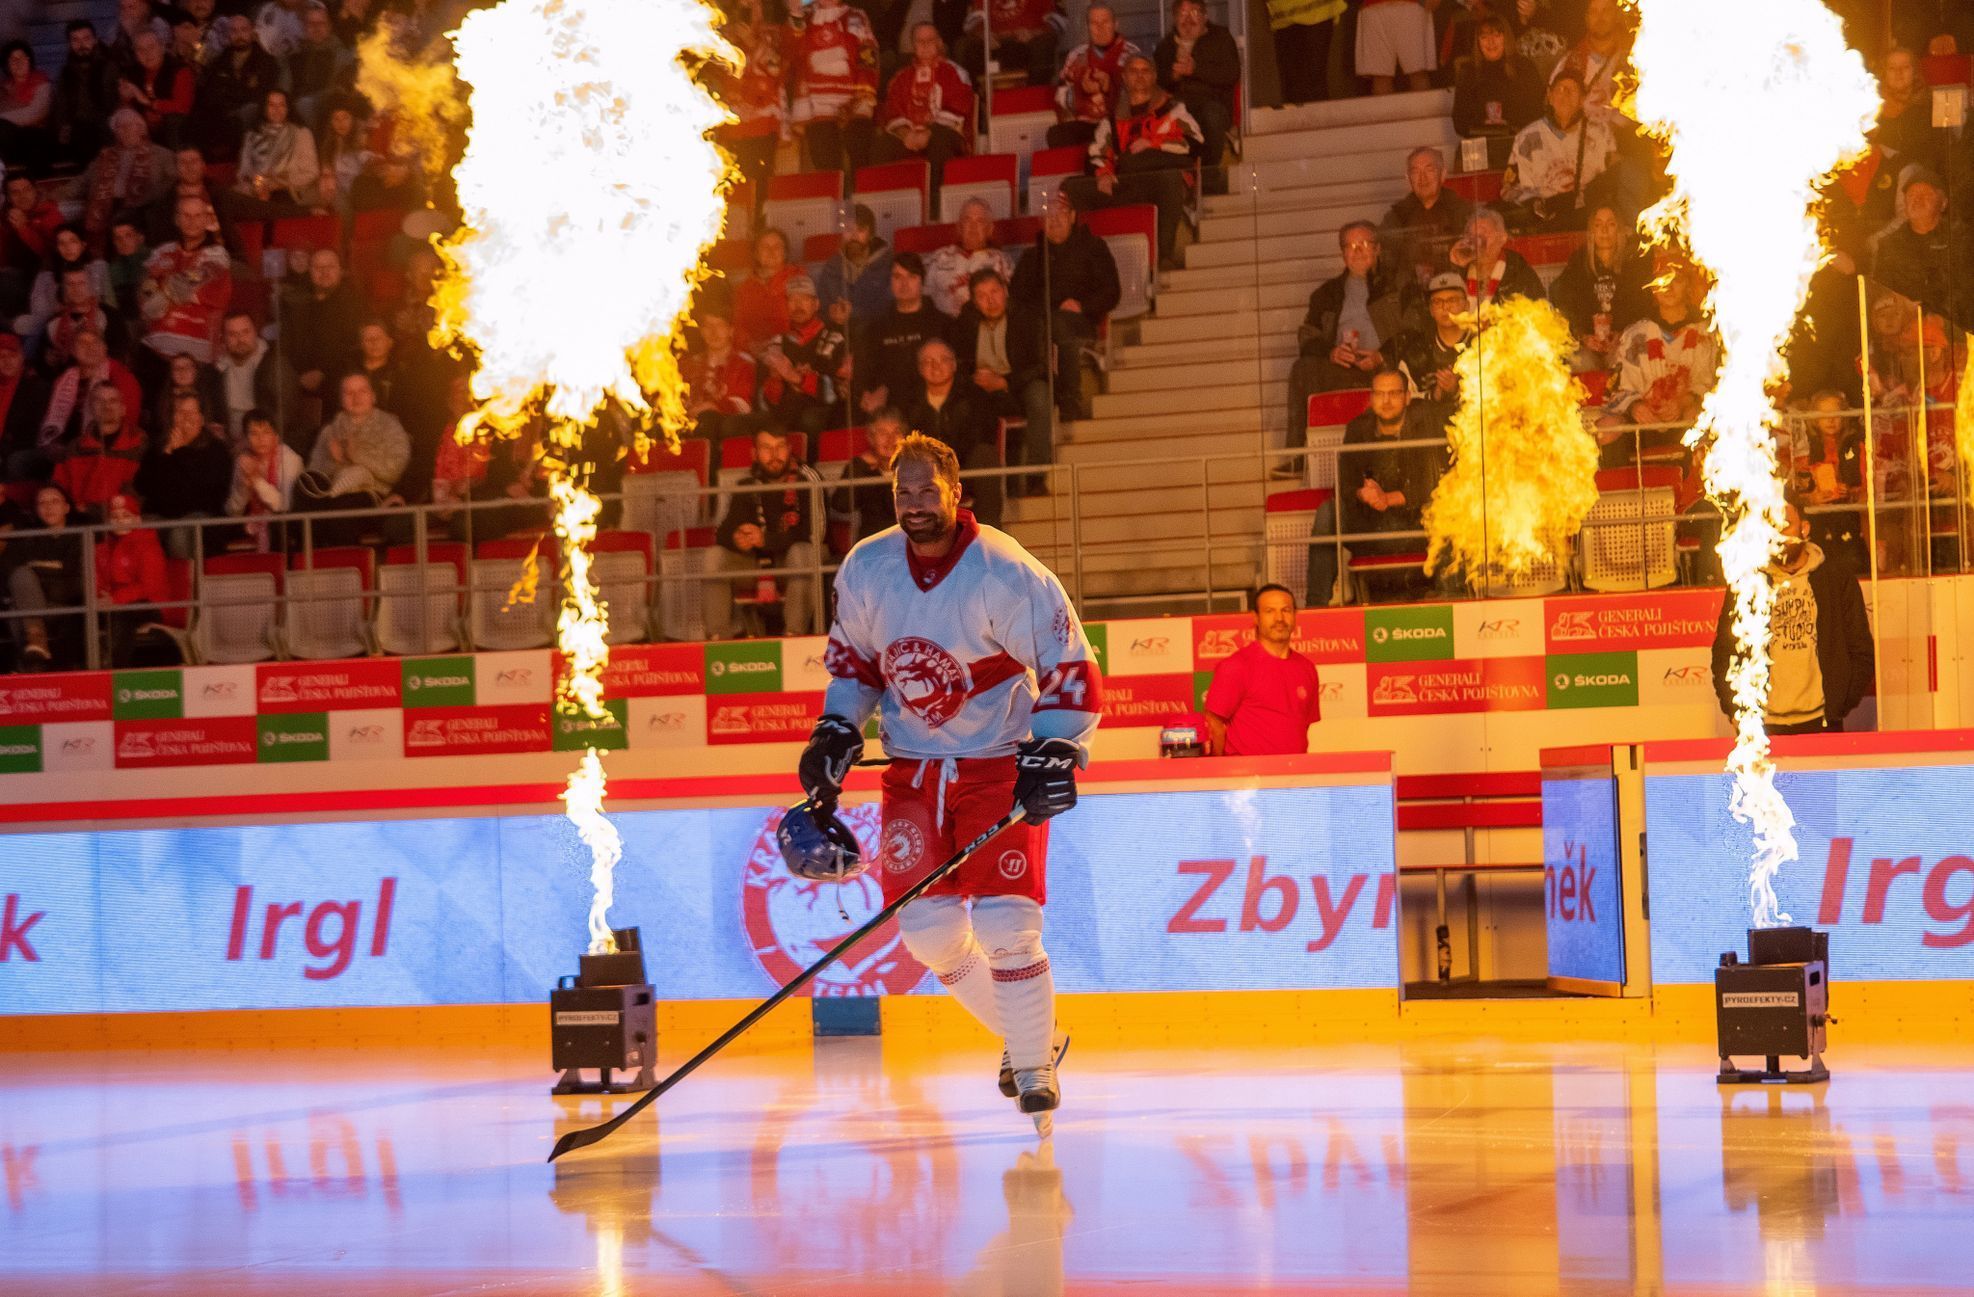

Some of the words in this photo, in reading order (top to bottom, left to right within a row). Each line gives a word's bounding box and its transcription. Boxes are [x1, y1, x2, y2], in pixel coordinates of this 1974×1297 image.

[1598, 608, 1662, 623] GENERALI
[1392, 626, 1446, 641] ŠKODA
[1598, 622, 1640, 639] ČESKÁ
[1644, 618, 1718, 637] POJIŠŤOVN
[1037, 666, 1086, 706] 24
[1418, 672, 1481, 687] GENERALI
[1574, 673, 1631, 687] ŠKODA
[1419, 686, 1459, 702] ČESKÁ
[1463, 683, 1539, 701] POJIŠŤOVNA
[752, 704, 807, 719] GENERALI
